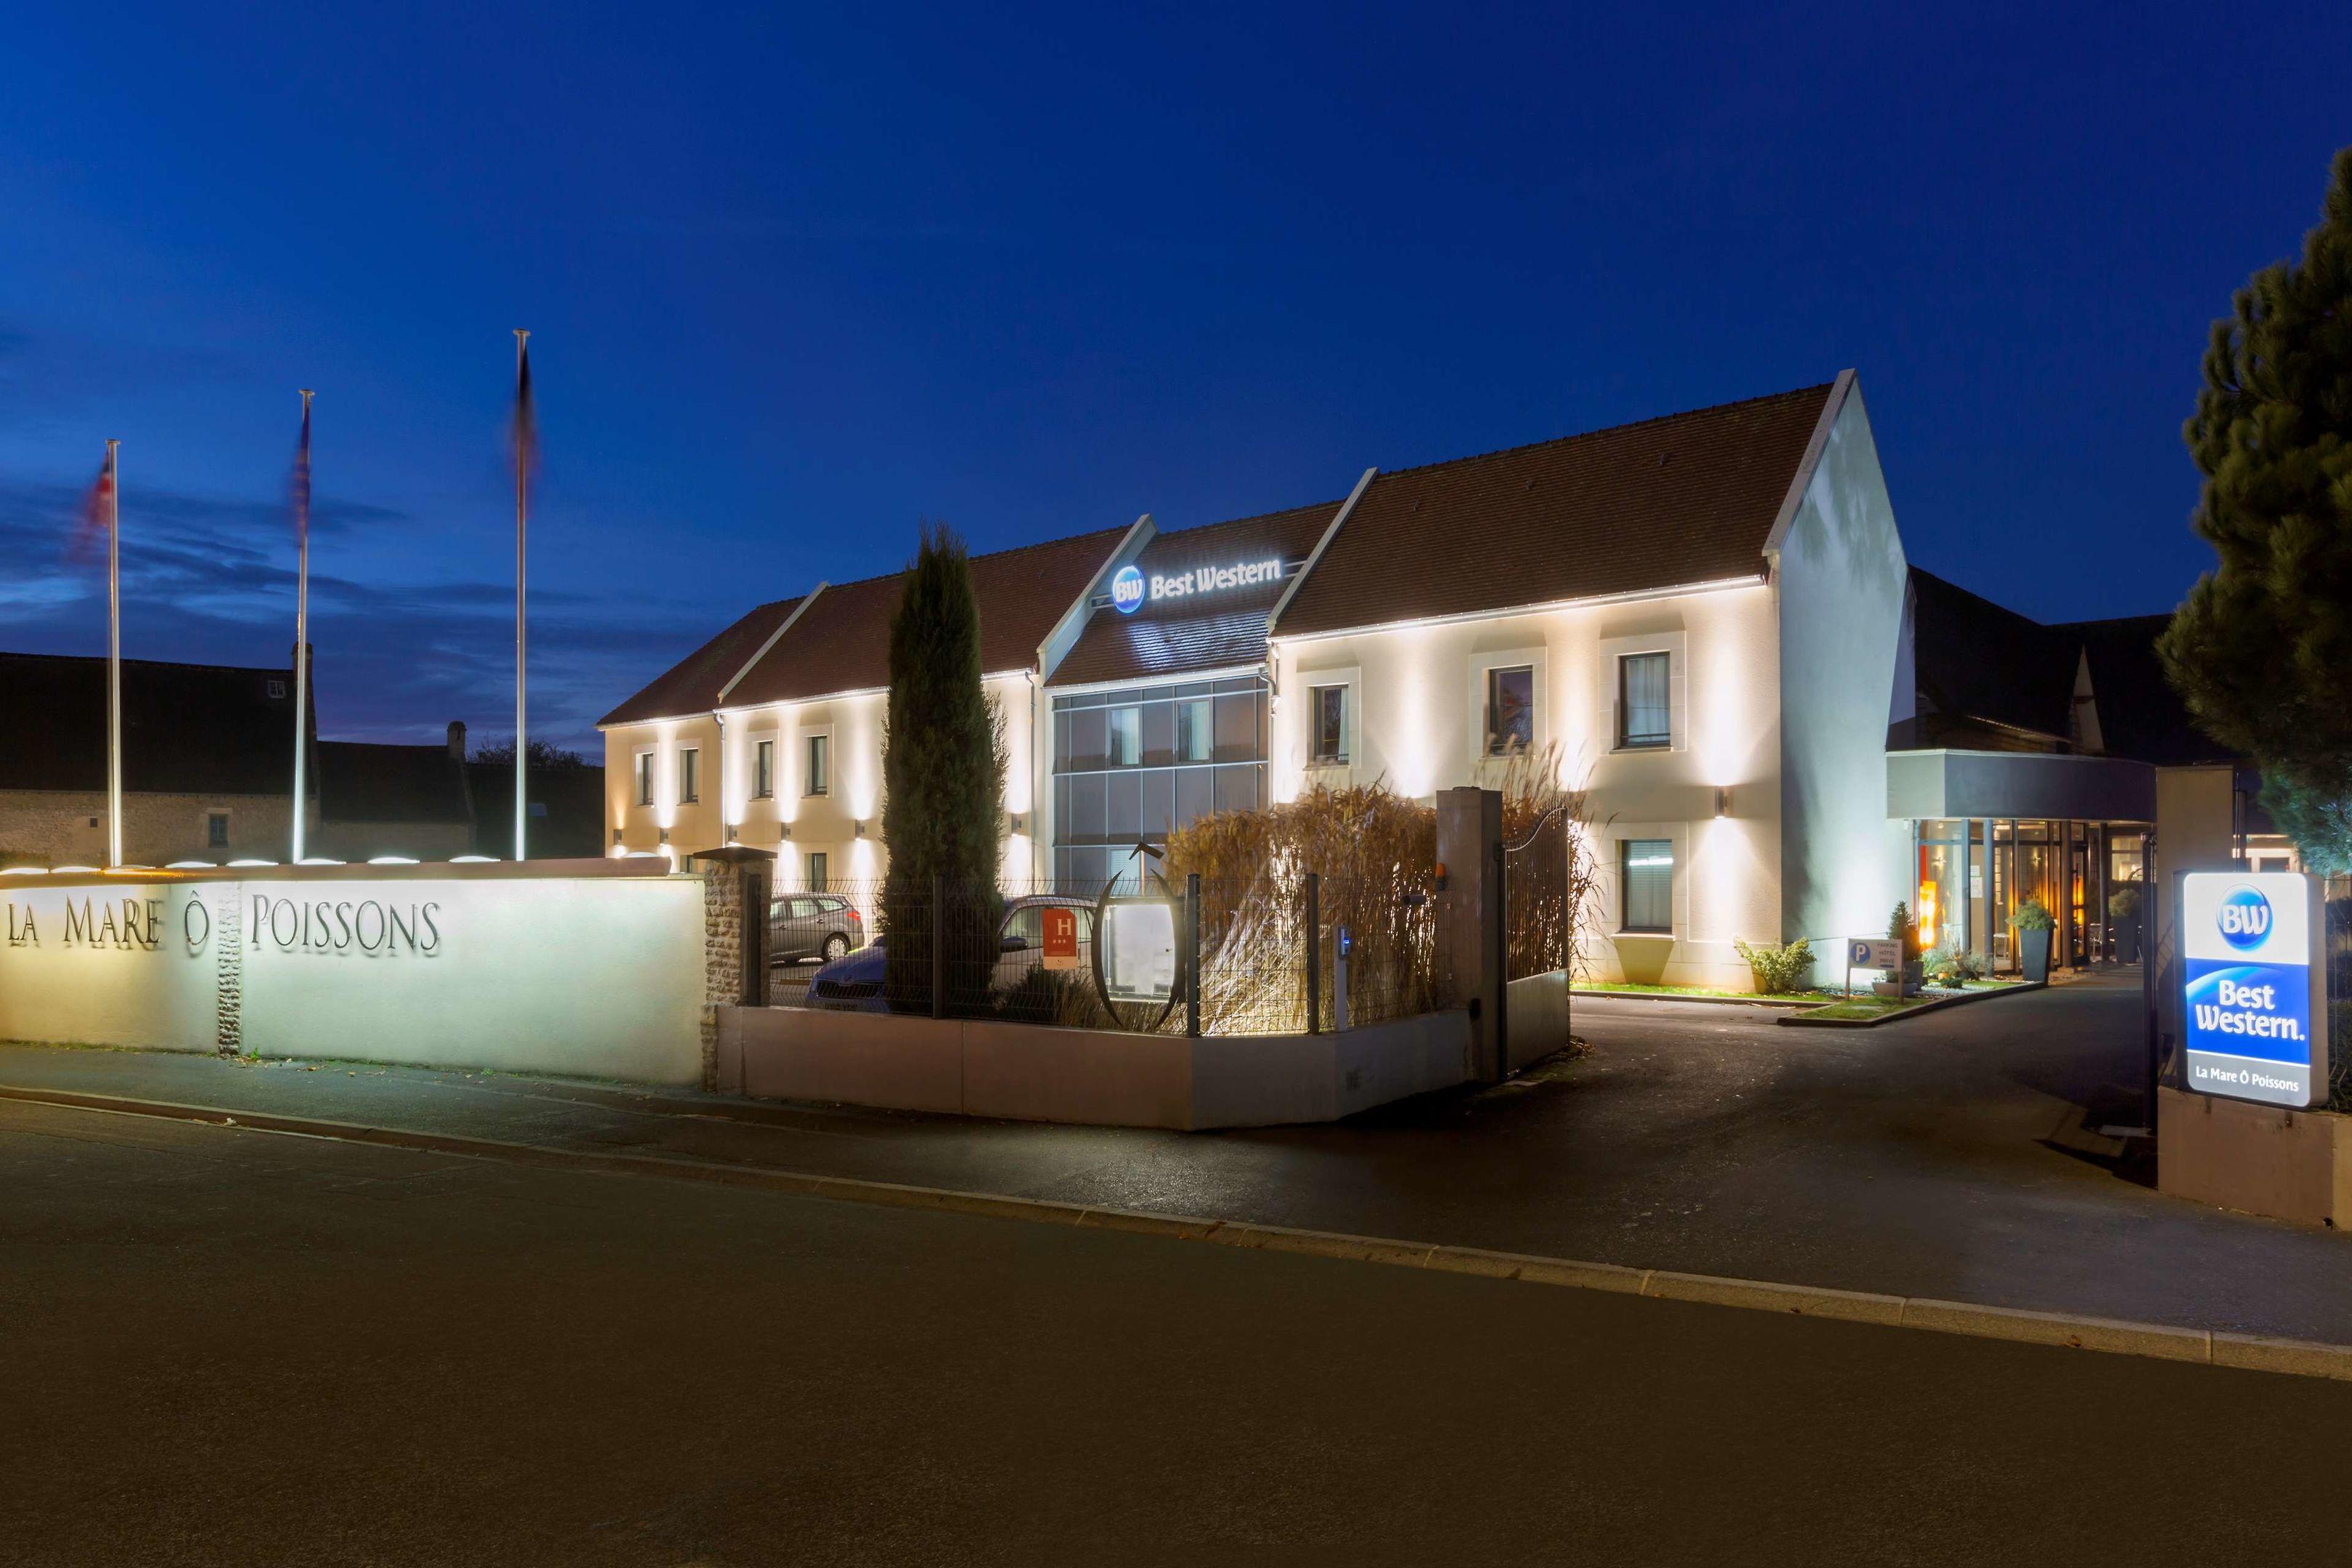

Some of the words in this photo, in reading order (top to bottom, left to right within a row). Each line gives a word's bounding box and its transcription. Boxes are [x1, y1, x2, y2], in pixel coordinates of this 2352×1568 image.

[1115, 579, 1143, 603] BW
[1151, 573, 1194, 599] Best
[1197, 559, 1281, 592] Western
[7, 903, 38, 942] LA
[63, 894, 162, 943] MARE
[184, 890, 209, 945] Ô
[251, 894, 441, 950] POISSONS
[1057, 918, 1072, 936] H
[2223, 905, 2269, 935] BW
[1855, 944, 1866, 962] P
[2219, 979, 2276, 1010] Best
[2195, 1065, 2208, 1078] La
[2210, 1067, 2237, 1082] Mare
[2239, 1069, 2250, 1084] Ô
[2252, 1074, 2299, 1092] Poissons
